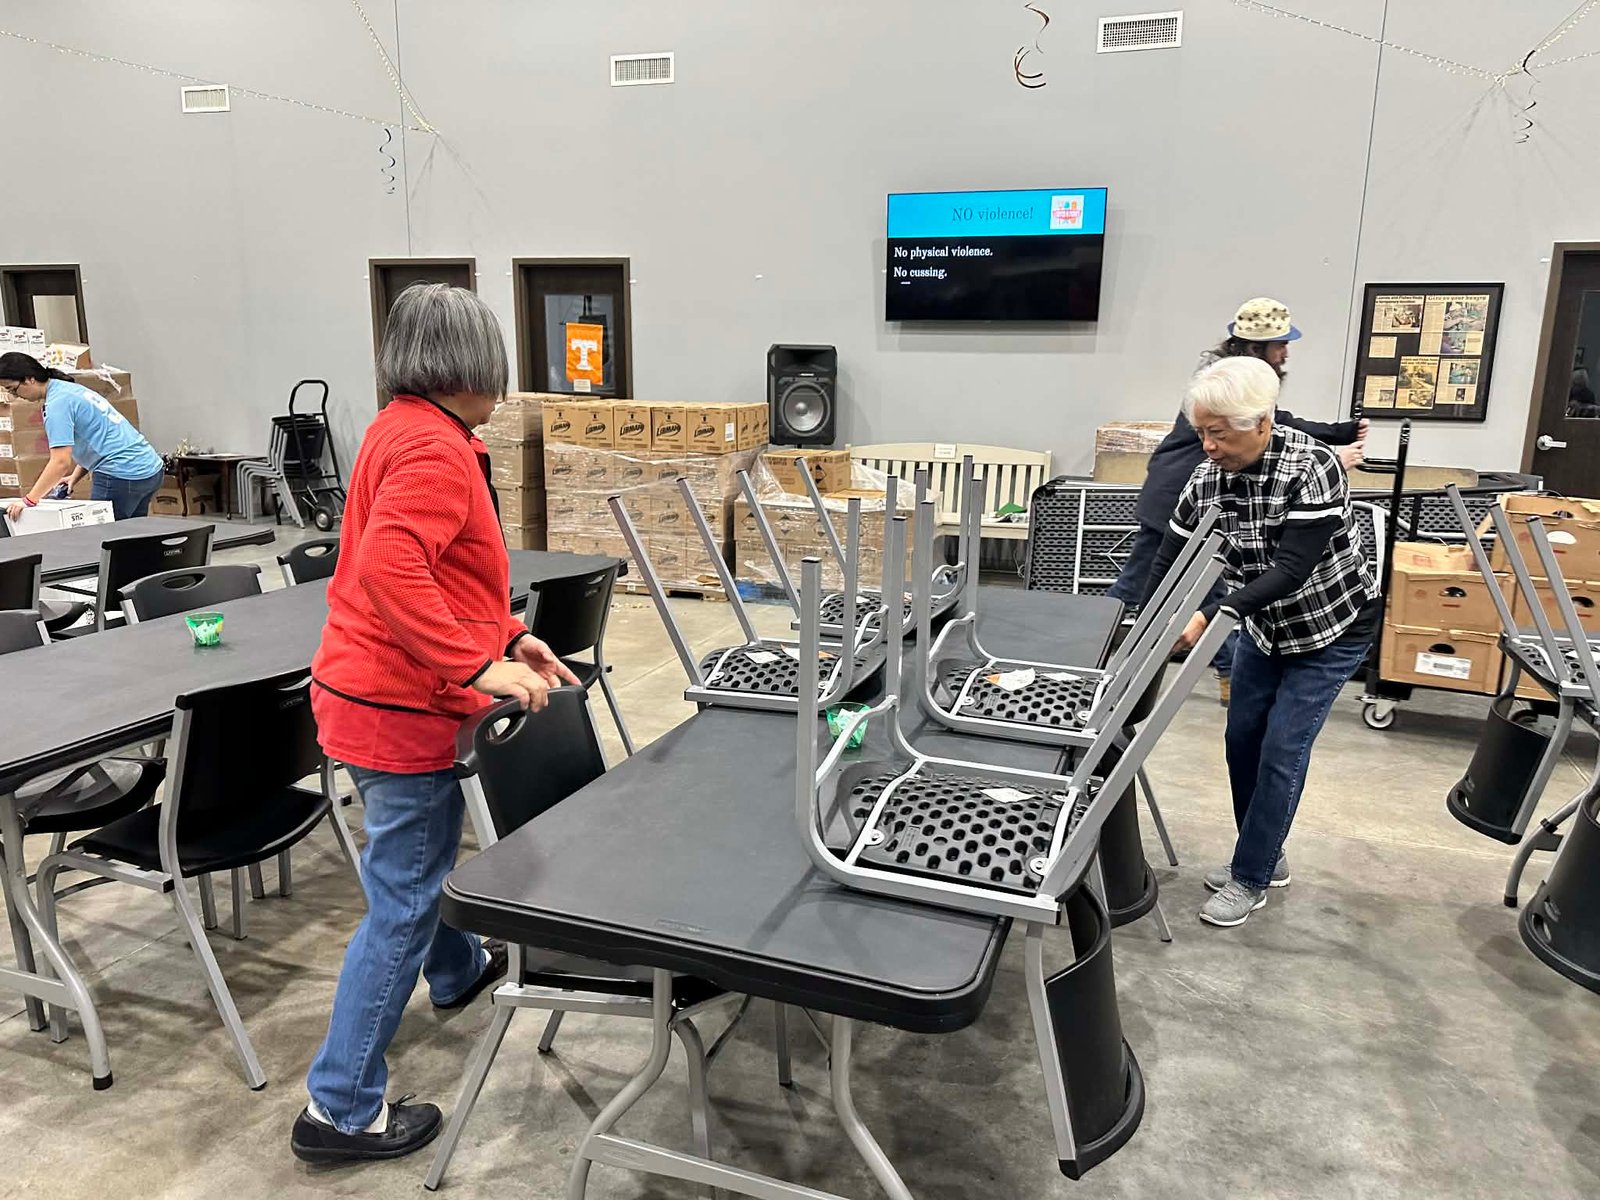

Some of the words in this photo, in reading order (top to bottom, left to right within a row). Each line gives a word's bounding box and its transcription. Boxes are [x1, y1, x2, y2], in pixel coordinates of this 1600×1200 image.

[952, 207, 973, 221] NO
[978, 206, 1034, 220] violence!
[893, 246, 908, 258] No
[910, 246, 949, 260] physical
[951, 245, 993, 257] violence.
[893, 266, 908, 278] No
[909, 266, 948, 280] cussing.
[571, 338, 598, 371] T
